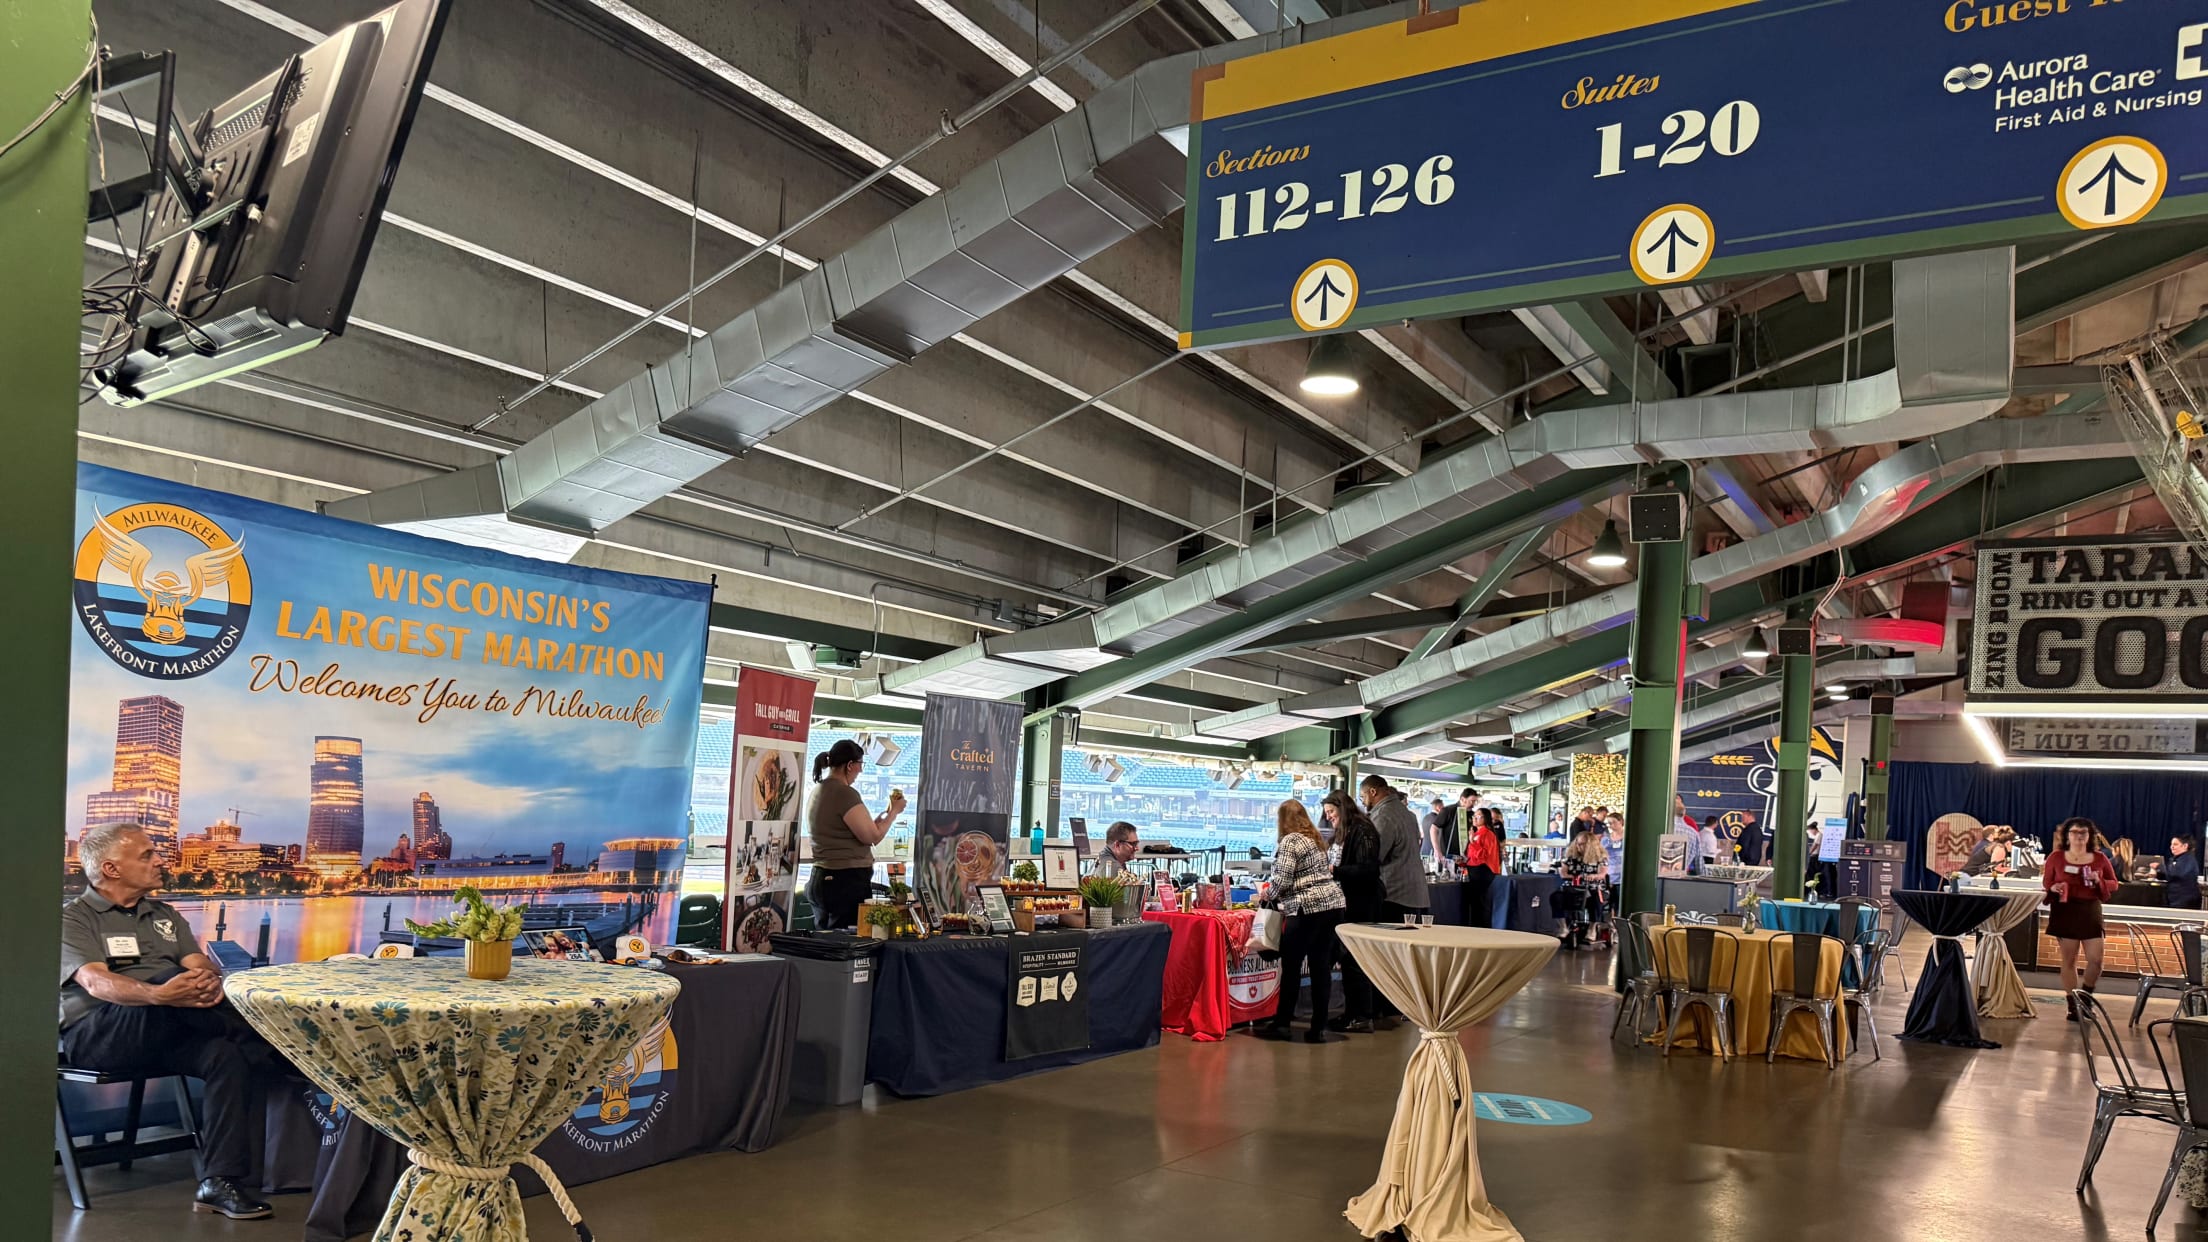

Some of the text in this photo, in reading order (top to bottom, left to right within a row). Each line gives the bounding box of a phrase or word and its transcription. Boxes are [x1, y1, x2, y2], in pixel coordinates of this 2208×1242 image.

[1944, 0, 2071, 33] Guest
[1997, 54, 2088, 84] Aurora
[1561, 74, 1660, 110] Suites
[1995, 69, 2155, 110] Health Care
[1995, 89, 2202, 132] First Aid & Nursing
[1593, 100, 1760, 178] 1-20
[1206, 144, 1311, 178] Sections
[1213, 154, 1455, 242] 112-126
[123, 510, 220, 544] MILWAUKEE
[368, 563, 611, 633] WISCONSIN'S
[2020, 588, 2198, 610] RING OUT A
[83, 603, 240, 675] LAKEFRONT MARATHON
[1985, 552, 2012, 689] ZING BOOM
[276, 600, 664, 681] LARGEST MARATHON
[249, 653, 670, 729] Welcomes You to Milwaukee!
[755, 703, 767, 719] TALL
[768, 705, 779, 720] GUY
[785, 708, 800, 723] GRILL
[950, 748, 995, 764] Crafted
[955, 763, 990, 772] TAVERN
[1022, 951, 1077, 963] BRAZEN STANDARD
[563, 1090, 670, 1153] KEFRONT MARATHON
